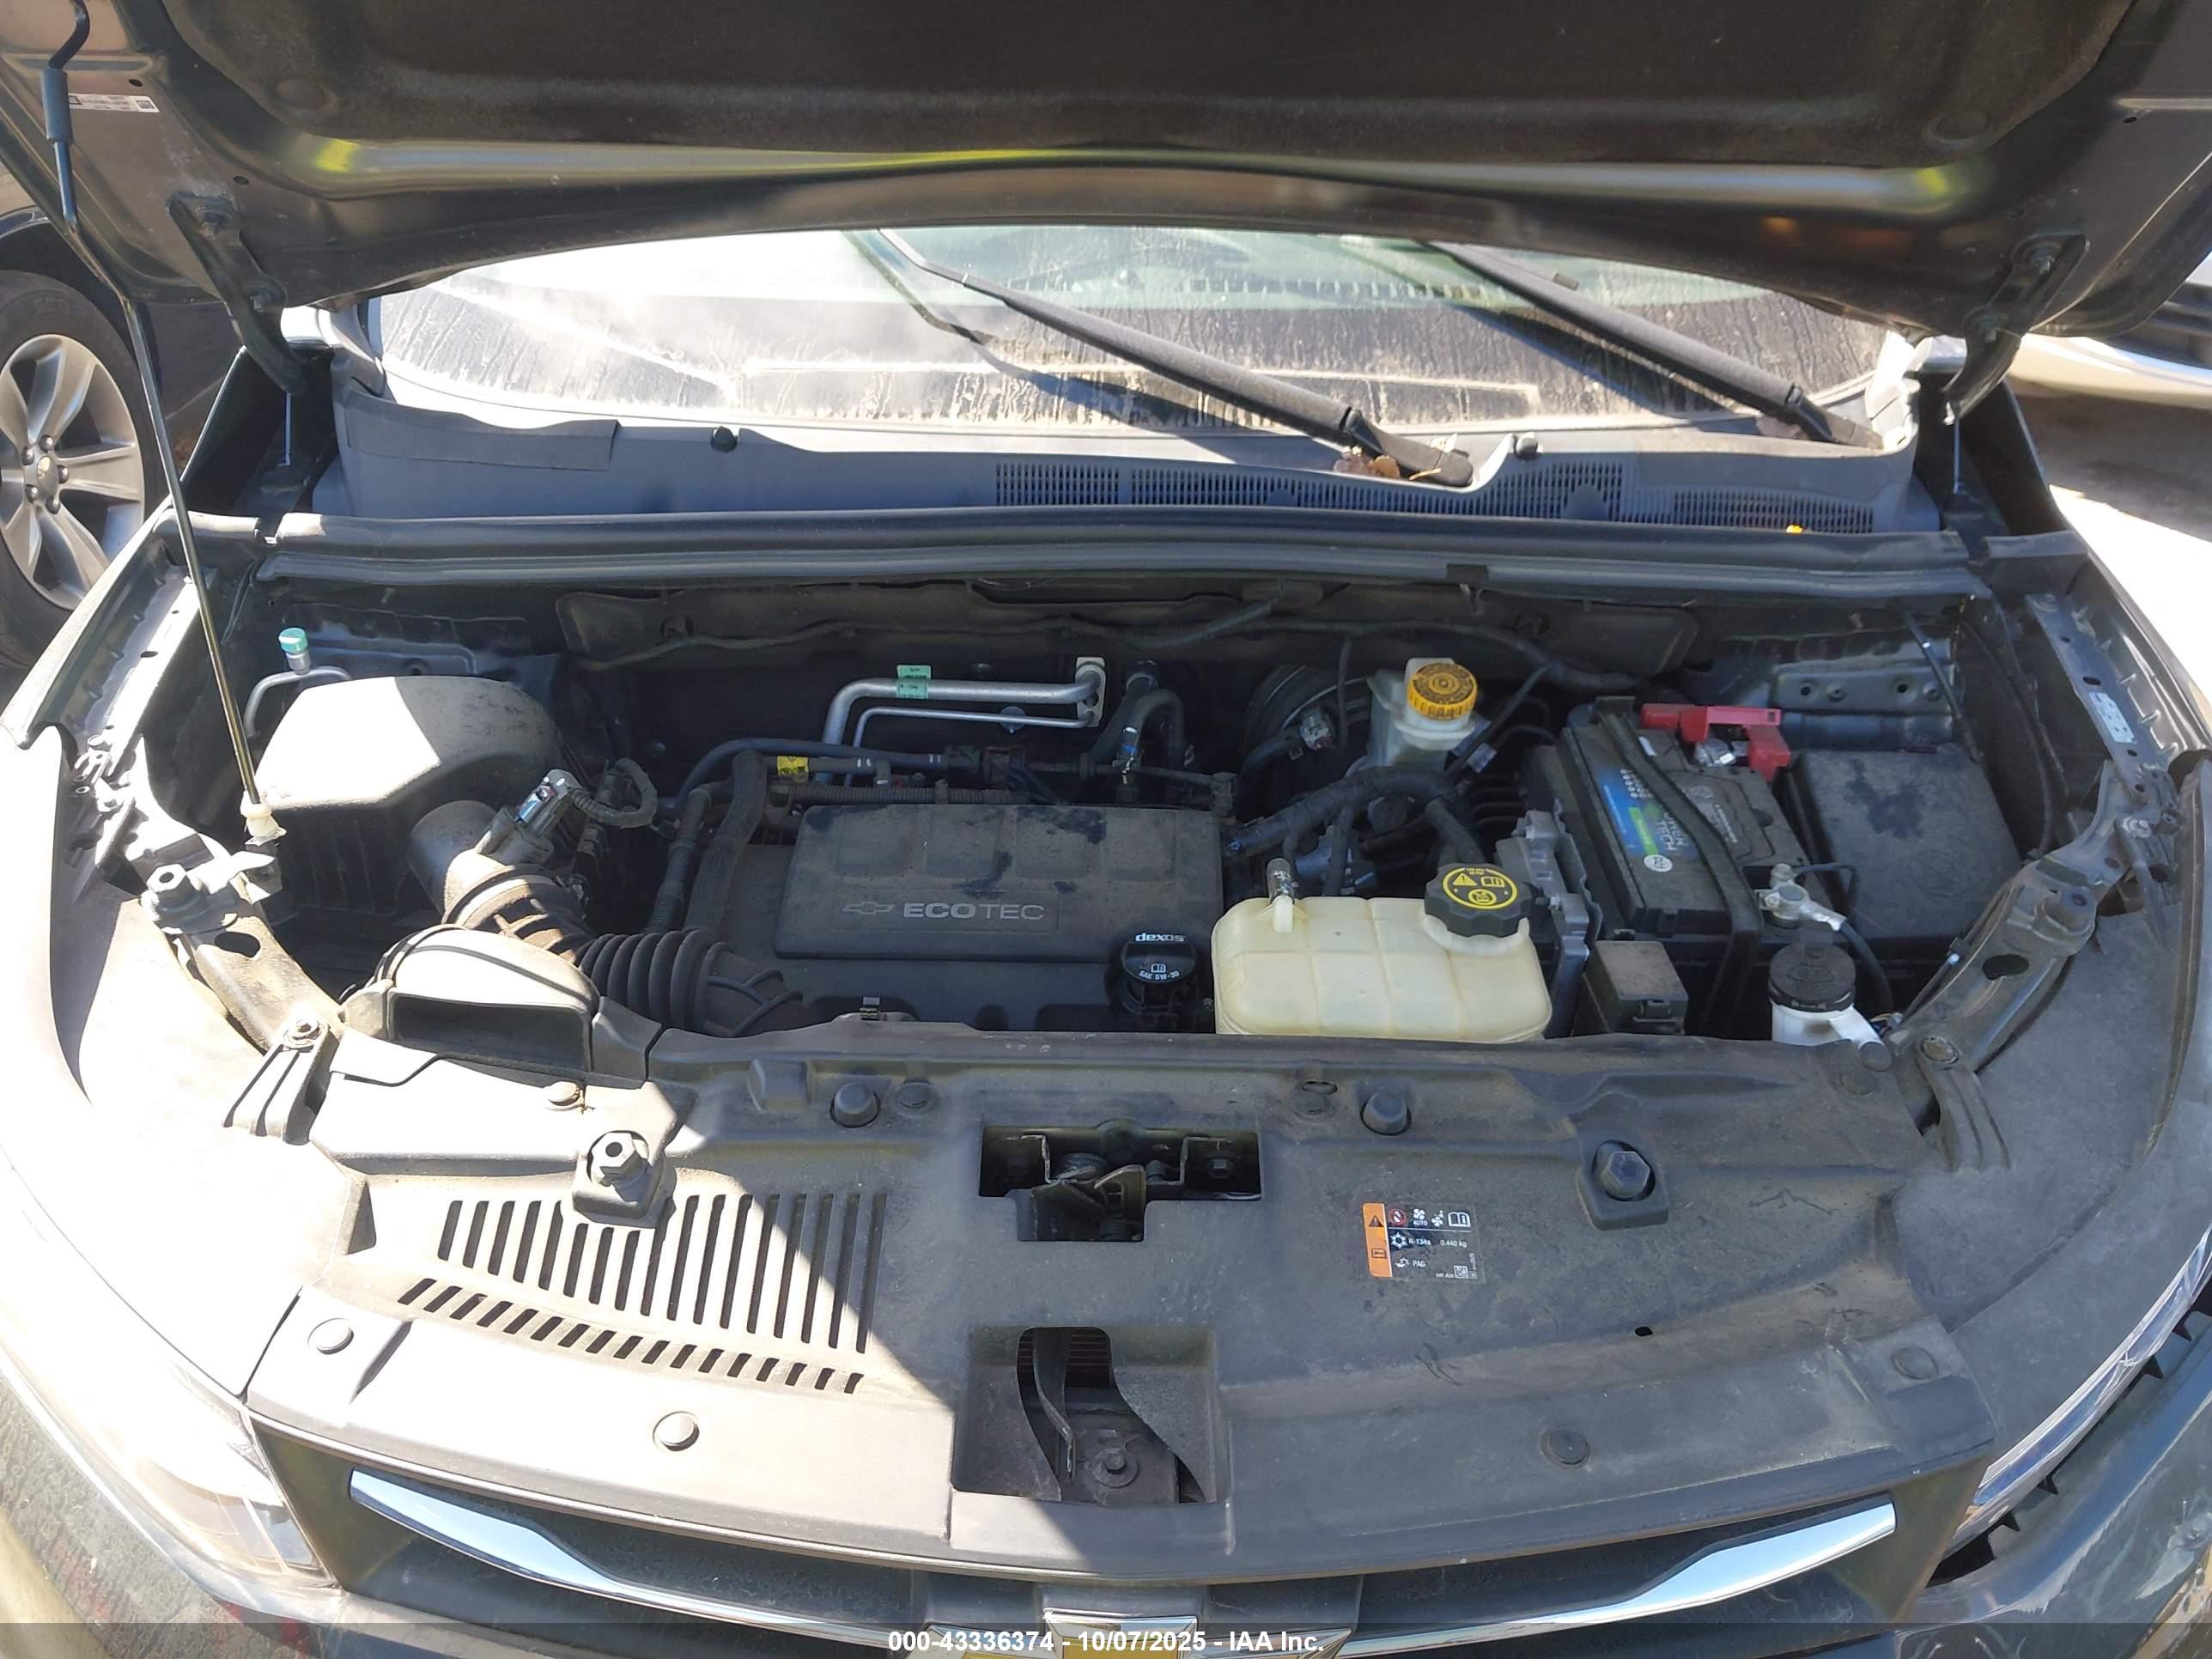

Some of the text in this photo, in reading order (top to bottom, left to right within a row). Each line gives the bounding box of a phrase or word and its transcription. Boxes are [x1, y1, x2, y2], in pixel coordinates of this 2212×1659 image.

[903, 902, 1044, 920] ECOTEC
[1135, 933, 1185, 942] dexos
[1139, 970, 1180, 981] SAE 5W-30
